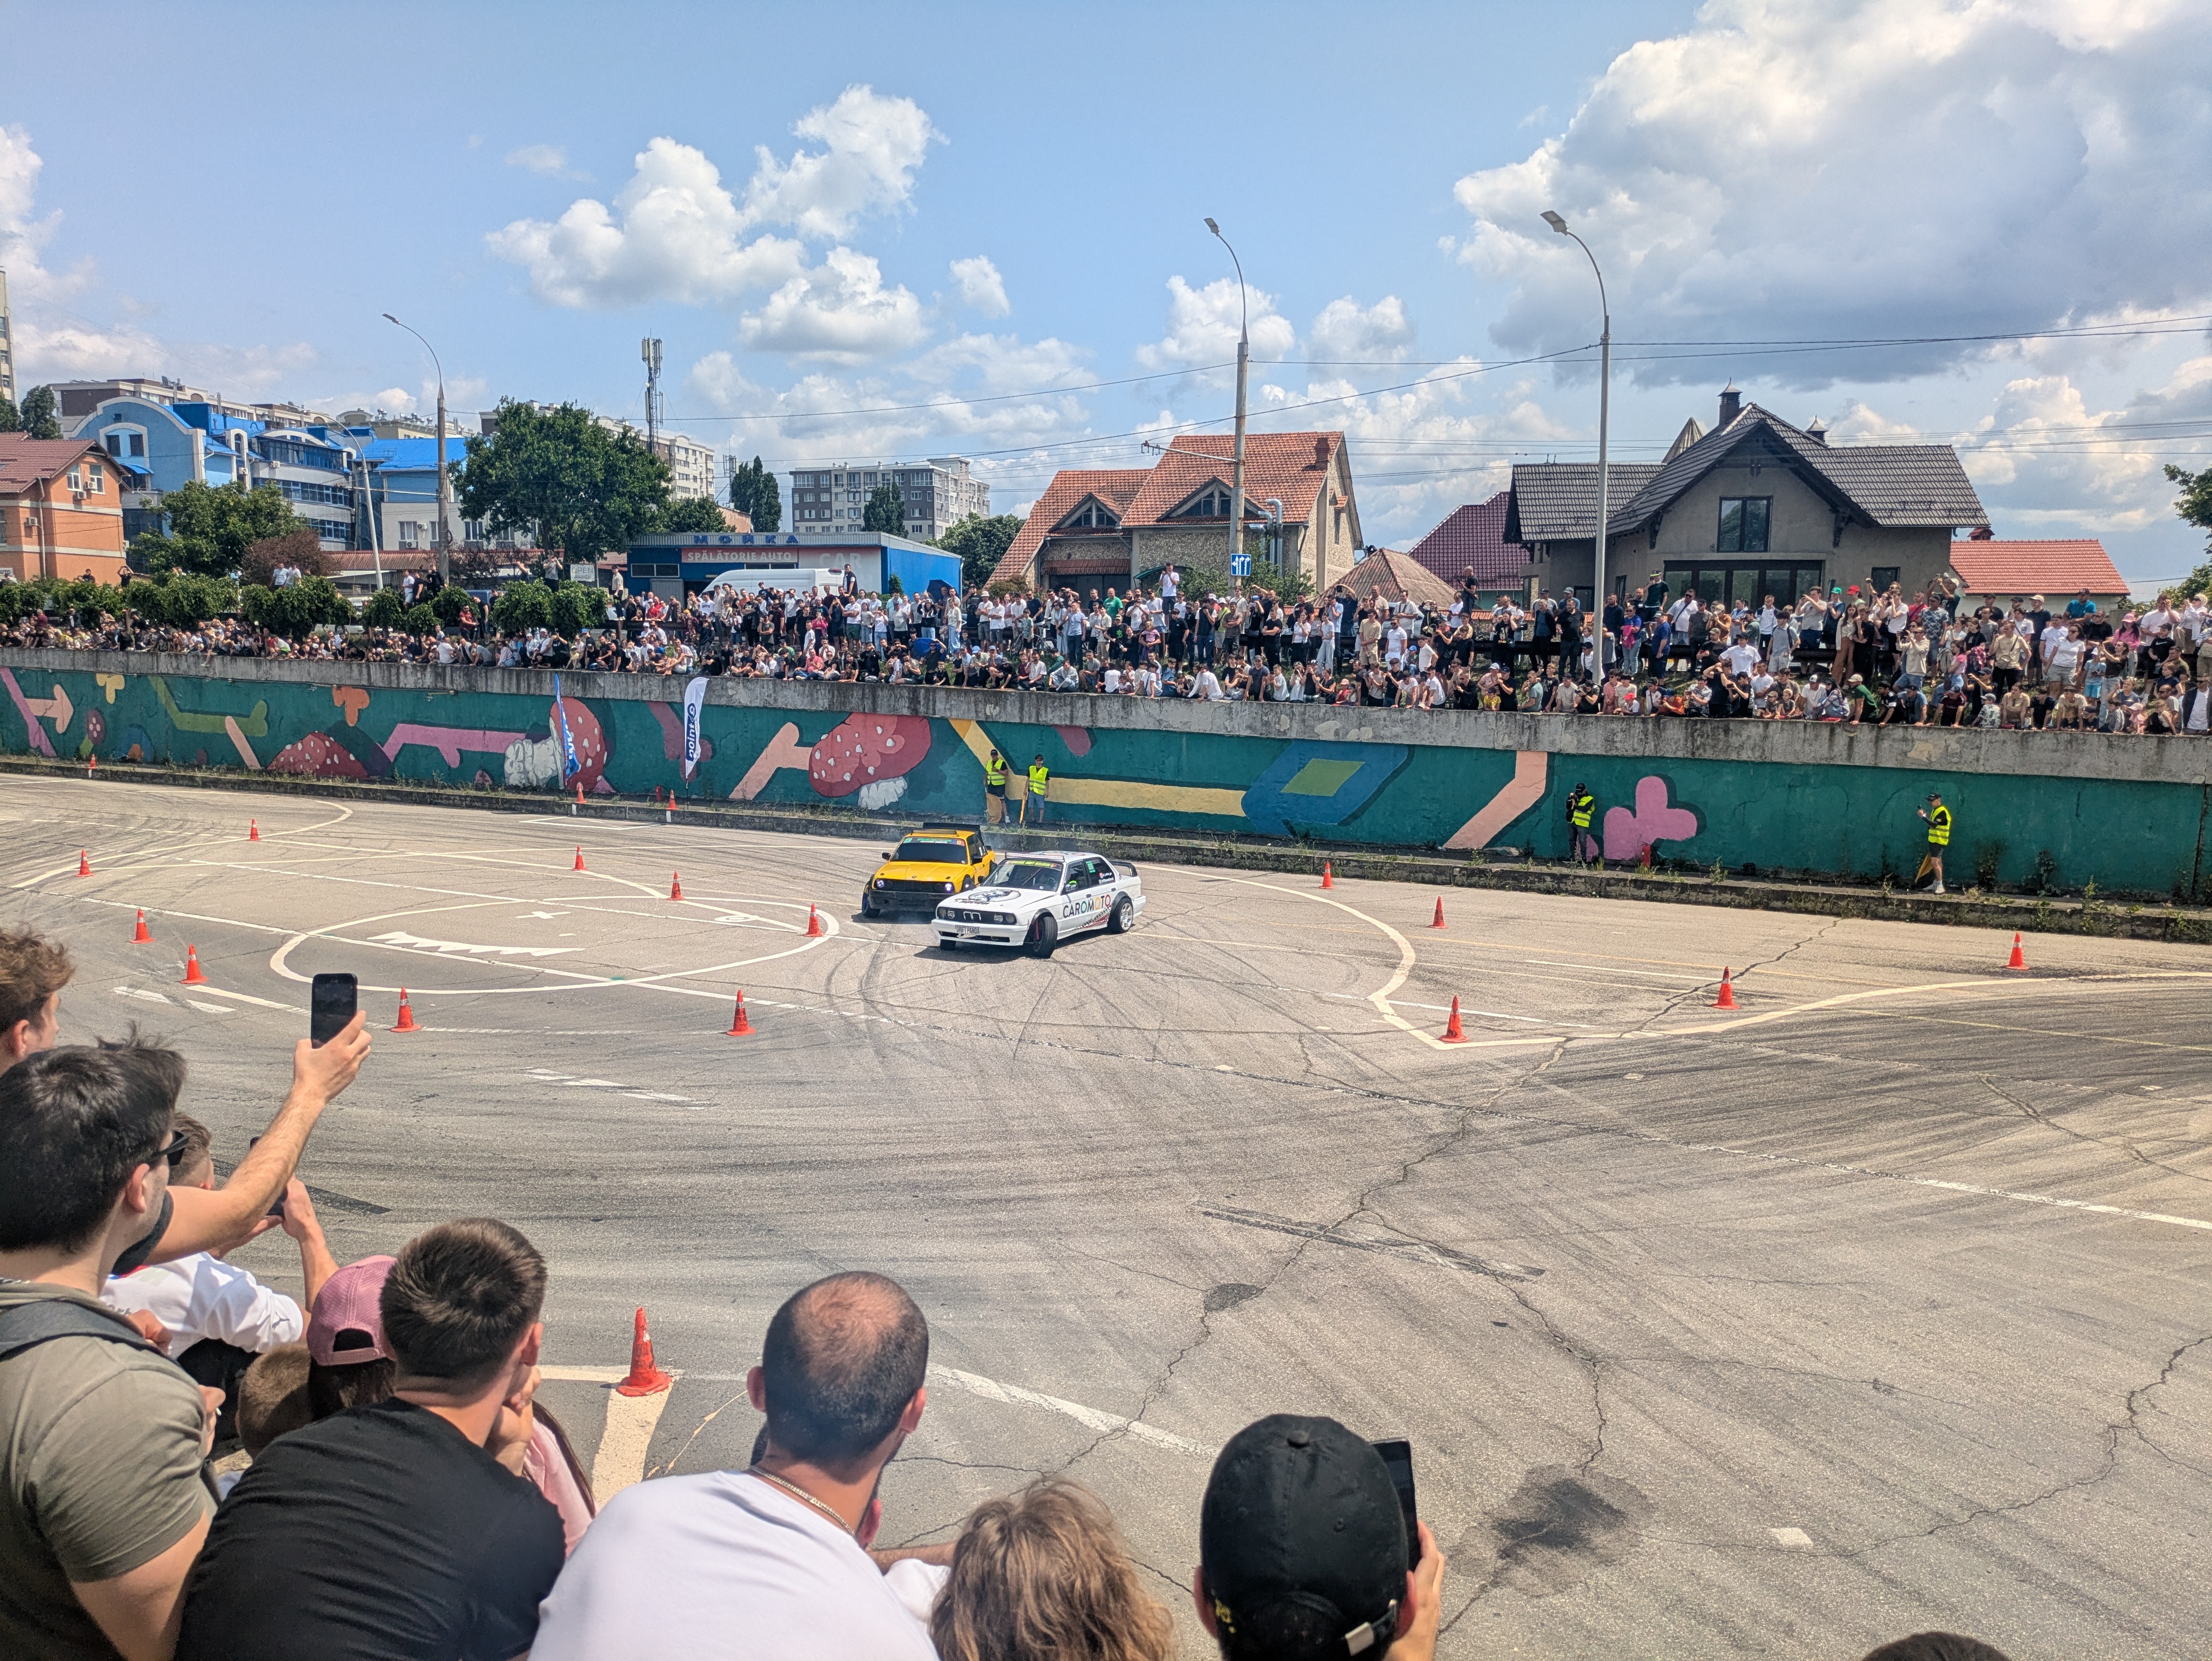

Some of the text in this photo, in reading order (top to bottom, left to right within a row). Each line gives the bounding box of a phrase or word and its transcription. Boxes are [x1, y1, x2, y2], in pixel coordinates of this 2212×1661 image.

[694, 533, 798, 543] МОЙКА
[688, 550, 791, 561] SPĂLĂTORIE AUTO
[819, 553, 862, 568] CAR
[687, 722, 695, 758] point
[1063, 894, 1111, 918] CAROMOTO
